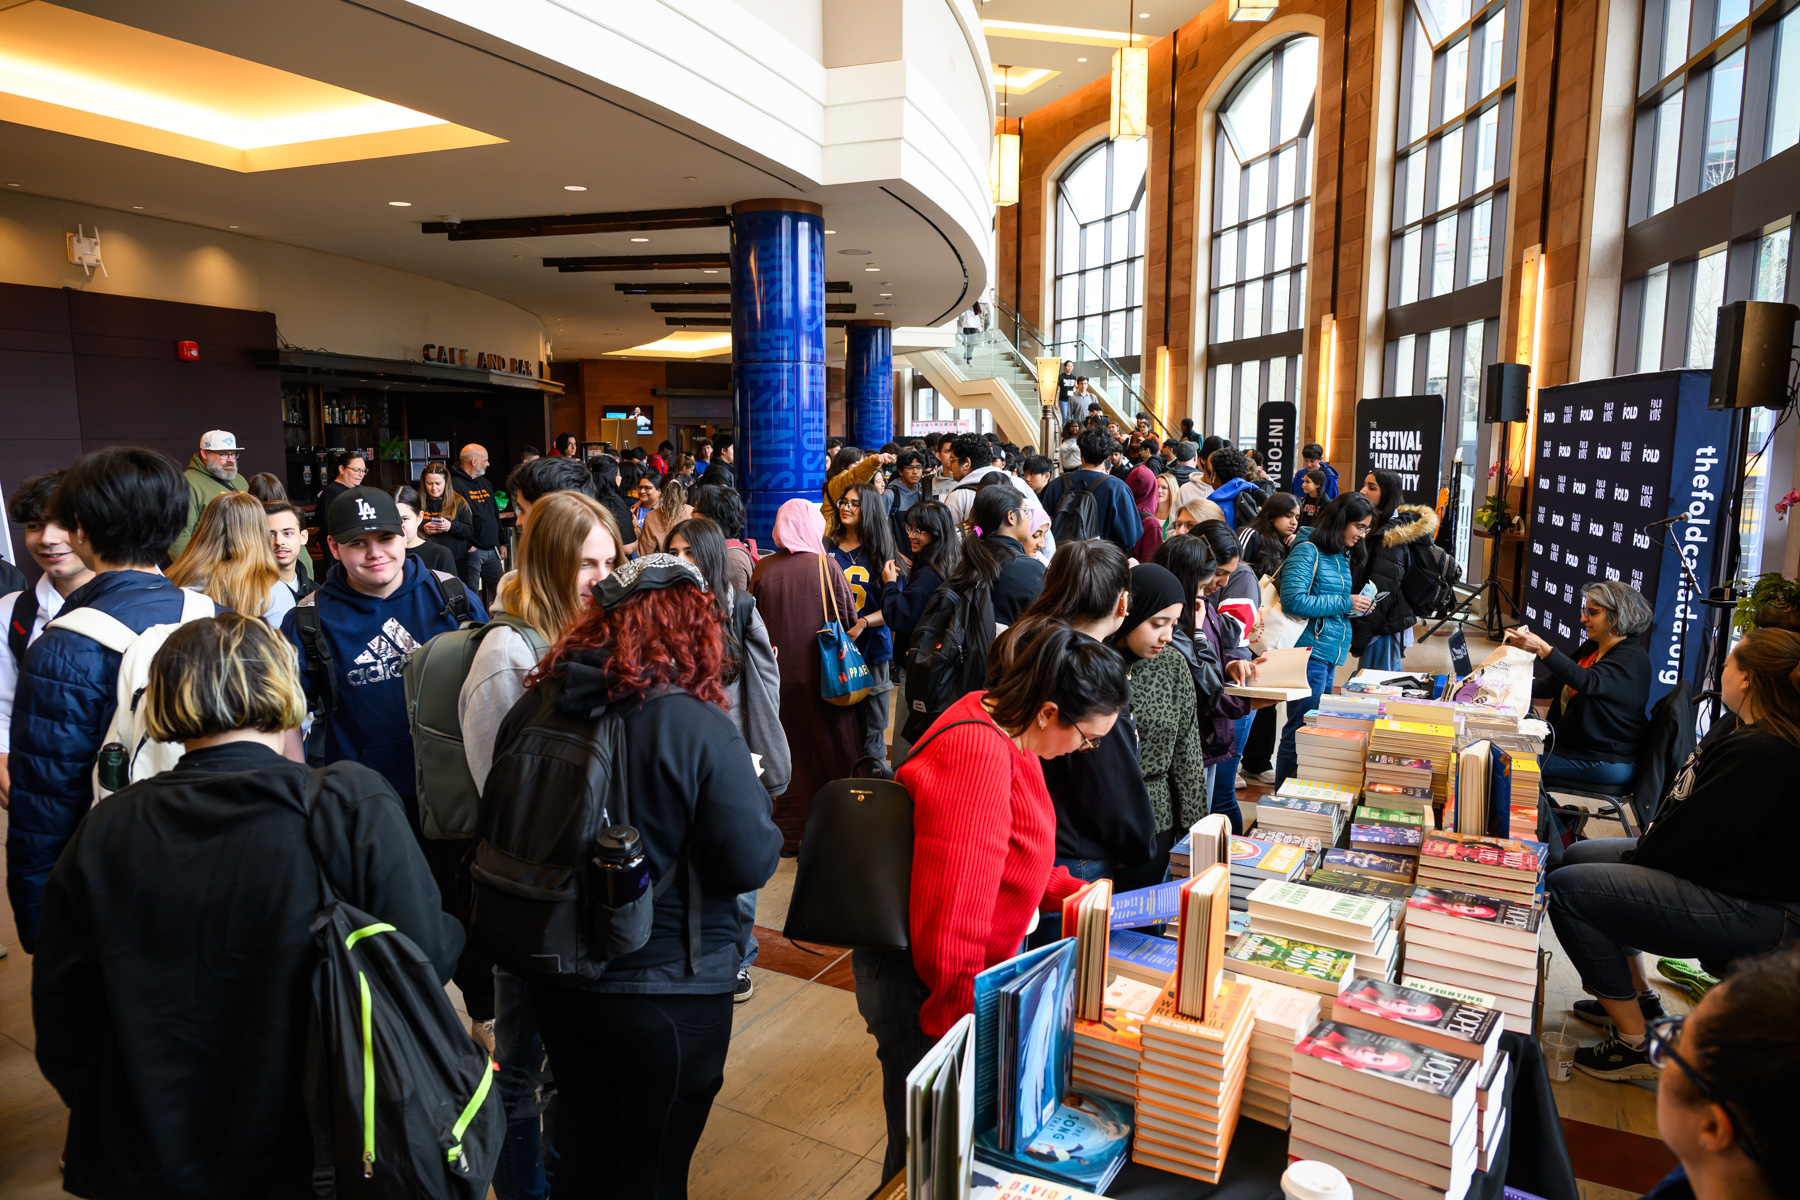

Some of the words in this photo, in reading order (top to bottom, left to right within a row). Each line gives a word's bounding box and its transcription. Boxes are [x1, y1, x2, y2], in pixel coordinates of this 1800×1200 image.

[422, 344, 468, 366] CAFE
[477, 352, 506, 371] AND
[510, 358, 532, 376] BAR
[1544, 412, 1555, 423] FOLD
[1580, 409, 1593, 421] FOLD
[1622, 406, 1638, 419] FOLD
[1369, 430, 1422, 451] FESTIVAL
[1559, 446, 1571, 457] FOLD
[1597, 447, 1611, 459] FOLD
[1642, 449, 1660, 463] FOLD
[1374, 452, 1421, 471] LITERARY
[1539, 478, 1549, 489] FOLD
[1573, 482, 1586, 494] FOLD
[1614, 488, 1629, 501] FOLD
[355, 499, 377, 520] LA
[1552, 514, 1564, 526] FOLD
[1589, 522, 1603, 536] FOLD
[1633, 533, 1650, 549] FOLD
[1533, 543, 1543, 555] FOLD
[1566, 553, 1578, 567] FOLD
[1606, 566, 1620, 581] FOLD
[1545, 581, 1557, 595] FOLD
[1526, 606, 1536, 620] FOLD
[1558, 623, 1571, 639] FOLD
[1503, 905, 1530, 929] HOPE
[1284, 947, 1314, 969] CHILD
[1309, 949, 1337, 979] GUTTER
[1428, 986, 1484, 1003] FIGHTING
[1449, 1003, 1488, 1041] HOPE
[1412, 1048, 1462, 1090] HOPE
[1053, 1114, 1080, 1141] SONG
[1072, 1126, 1086, 1137] THE
[1009, 1181, 1059, 1200] DAVID
